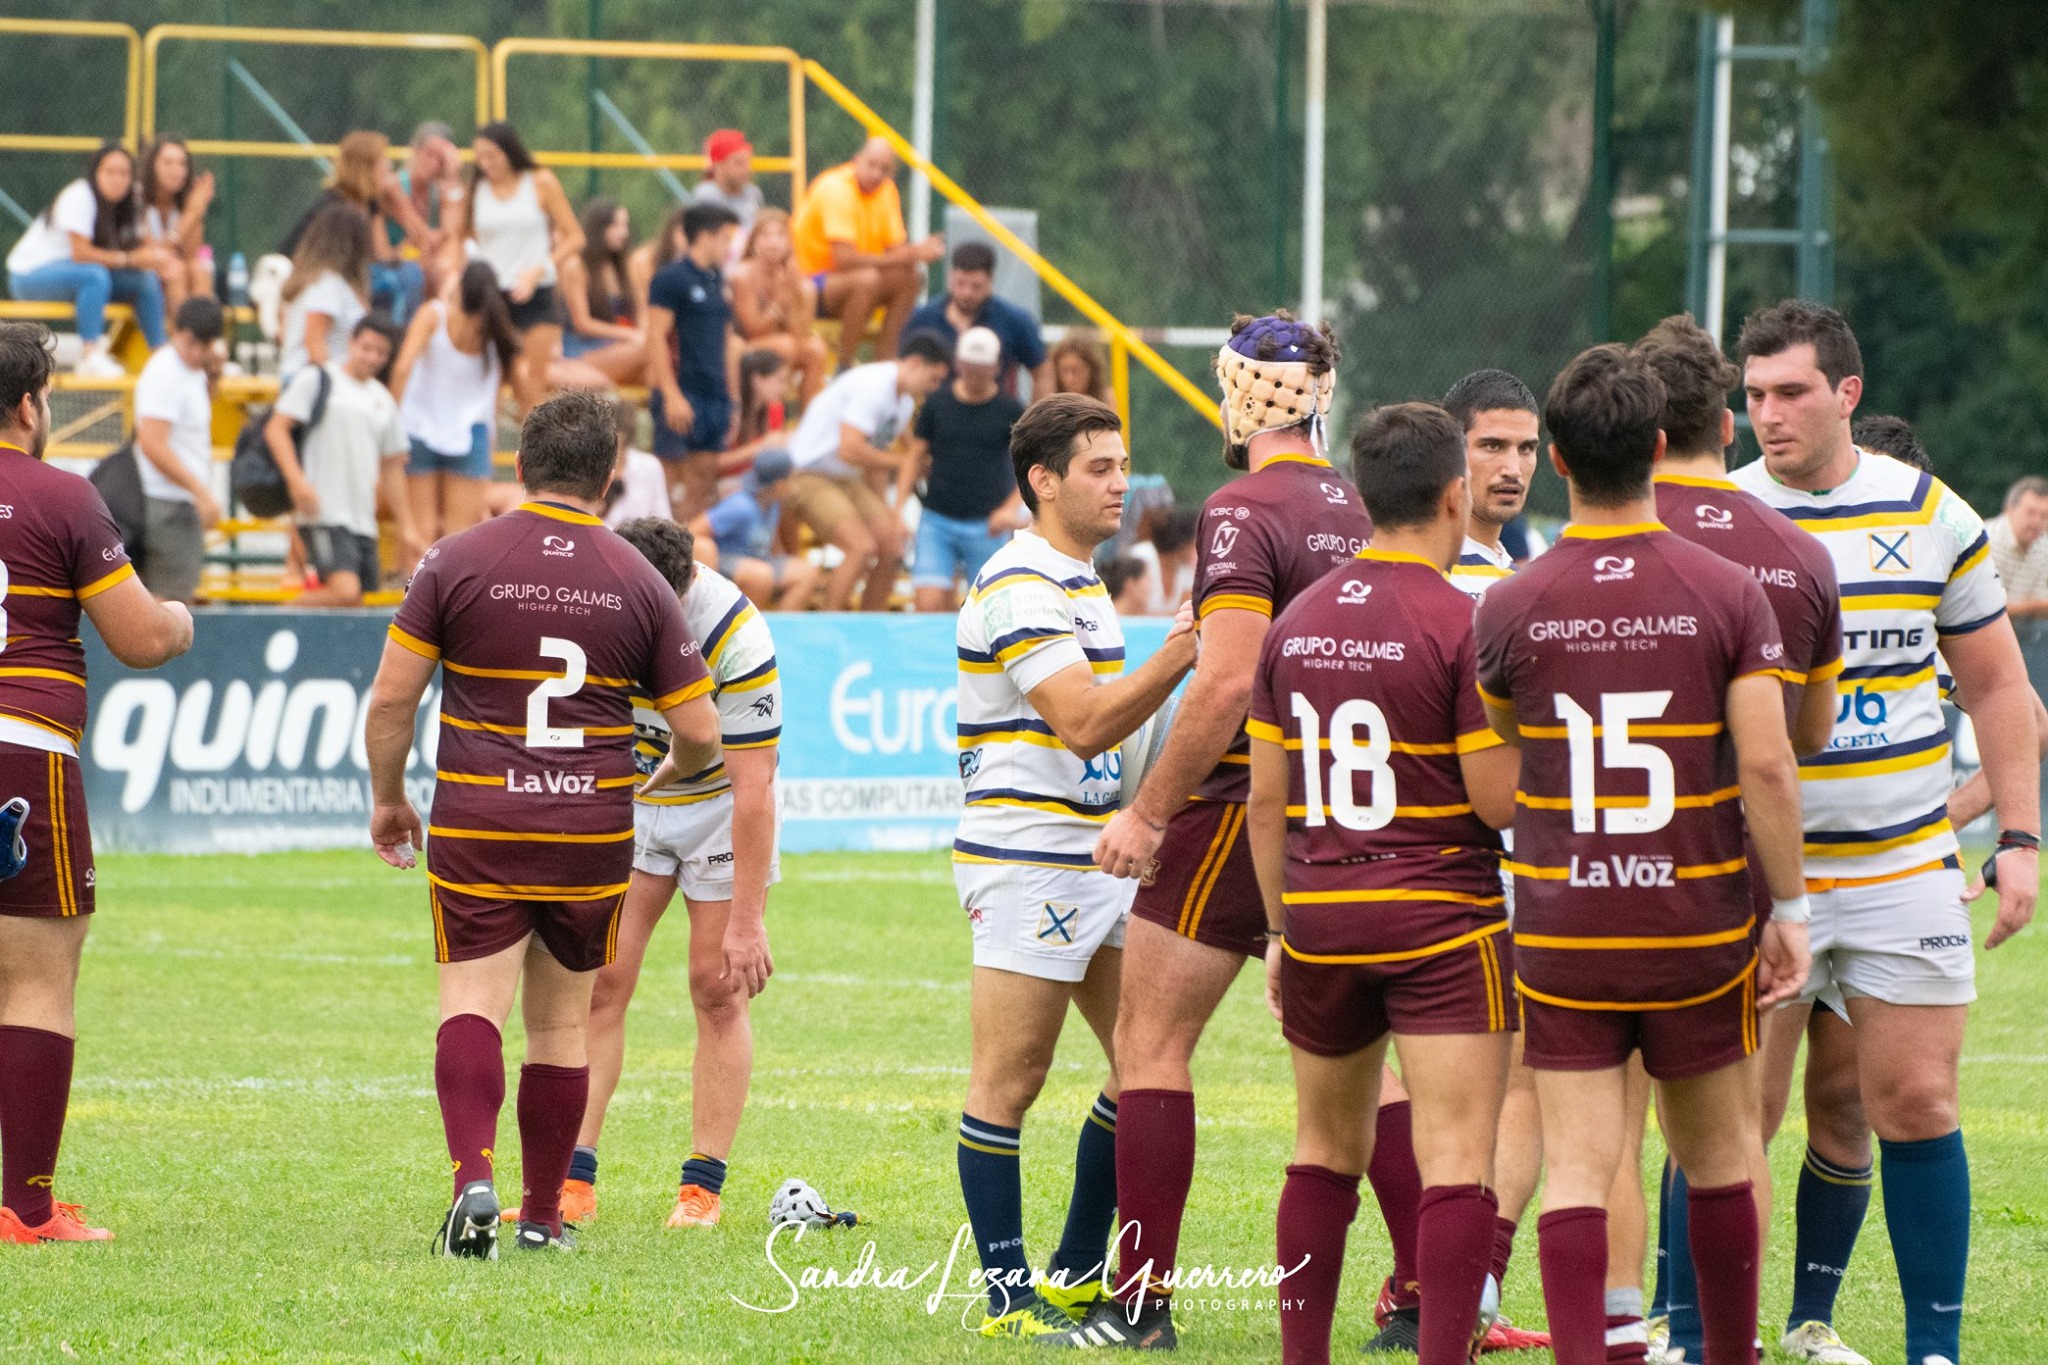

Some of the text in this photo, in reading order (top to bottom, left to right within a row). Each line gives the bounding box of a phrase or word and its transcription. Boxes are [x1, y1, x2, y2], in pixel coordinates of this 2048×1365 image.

[542, 548, 575, 558] quince
[1307, 533, 1347, 553] GRUPO
[490, 584, 622, 611] GRUPO GALMES
[518, 602, 591, 616] HIGHER TECH
[1528, 614, 1698, 642] GRUPO GALMES
[1282, 636, 1406, 662] GRUPO GALMES
[1564, 638, 1658, 653] HIGHER TECH
[1302, 658, 1373, 672] HIGHER TECH
[526, 636, 587, 748] 2
[1291, 691, 1398, 831] 18
[1553, 690, 1676, 835] 15
[507, 768, 596, 794] La Voz
[170, 777, 364, 815] INDUMENTARIA
[1569, 854, 1676, 888] La Voz
